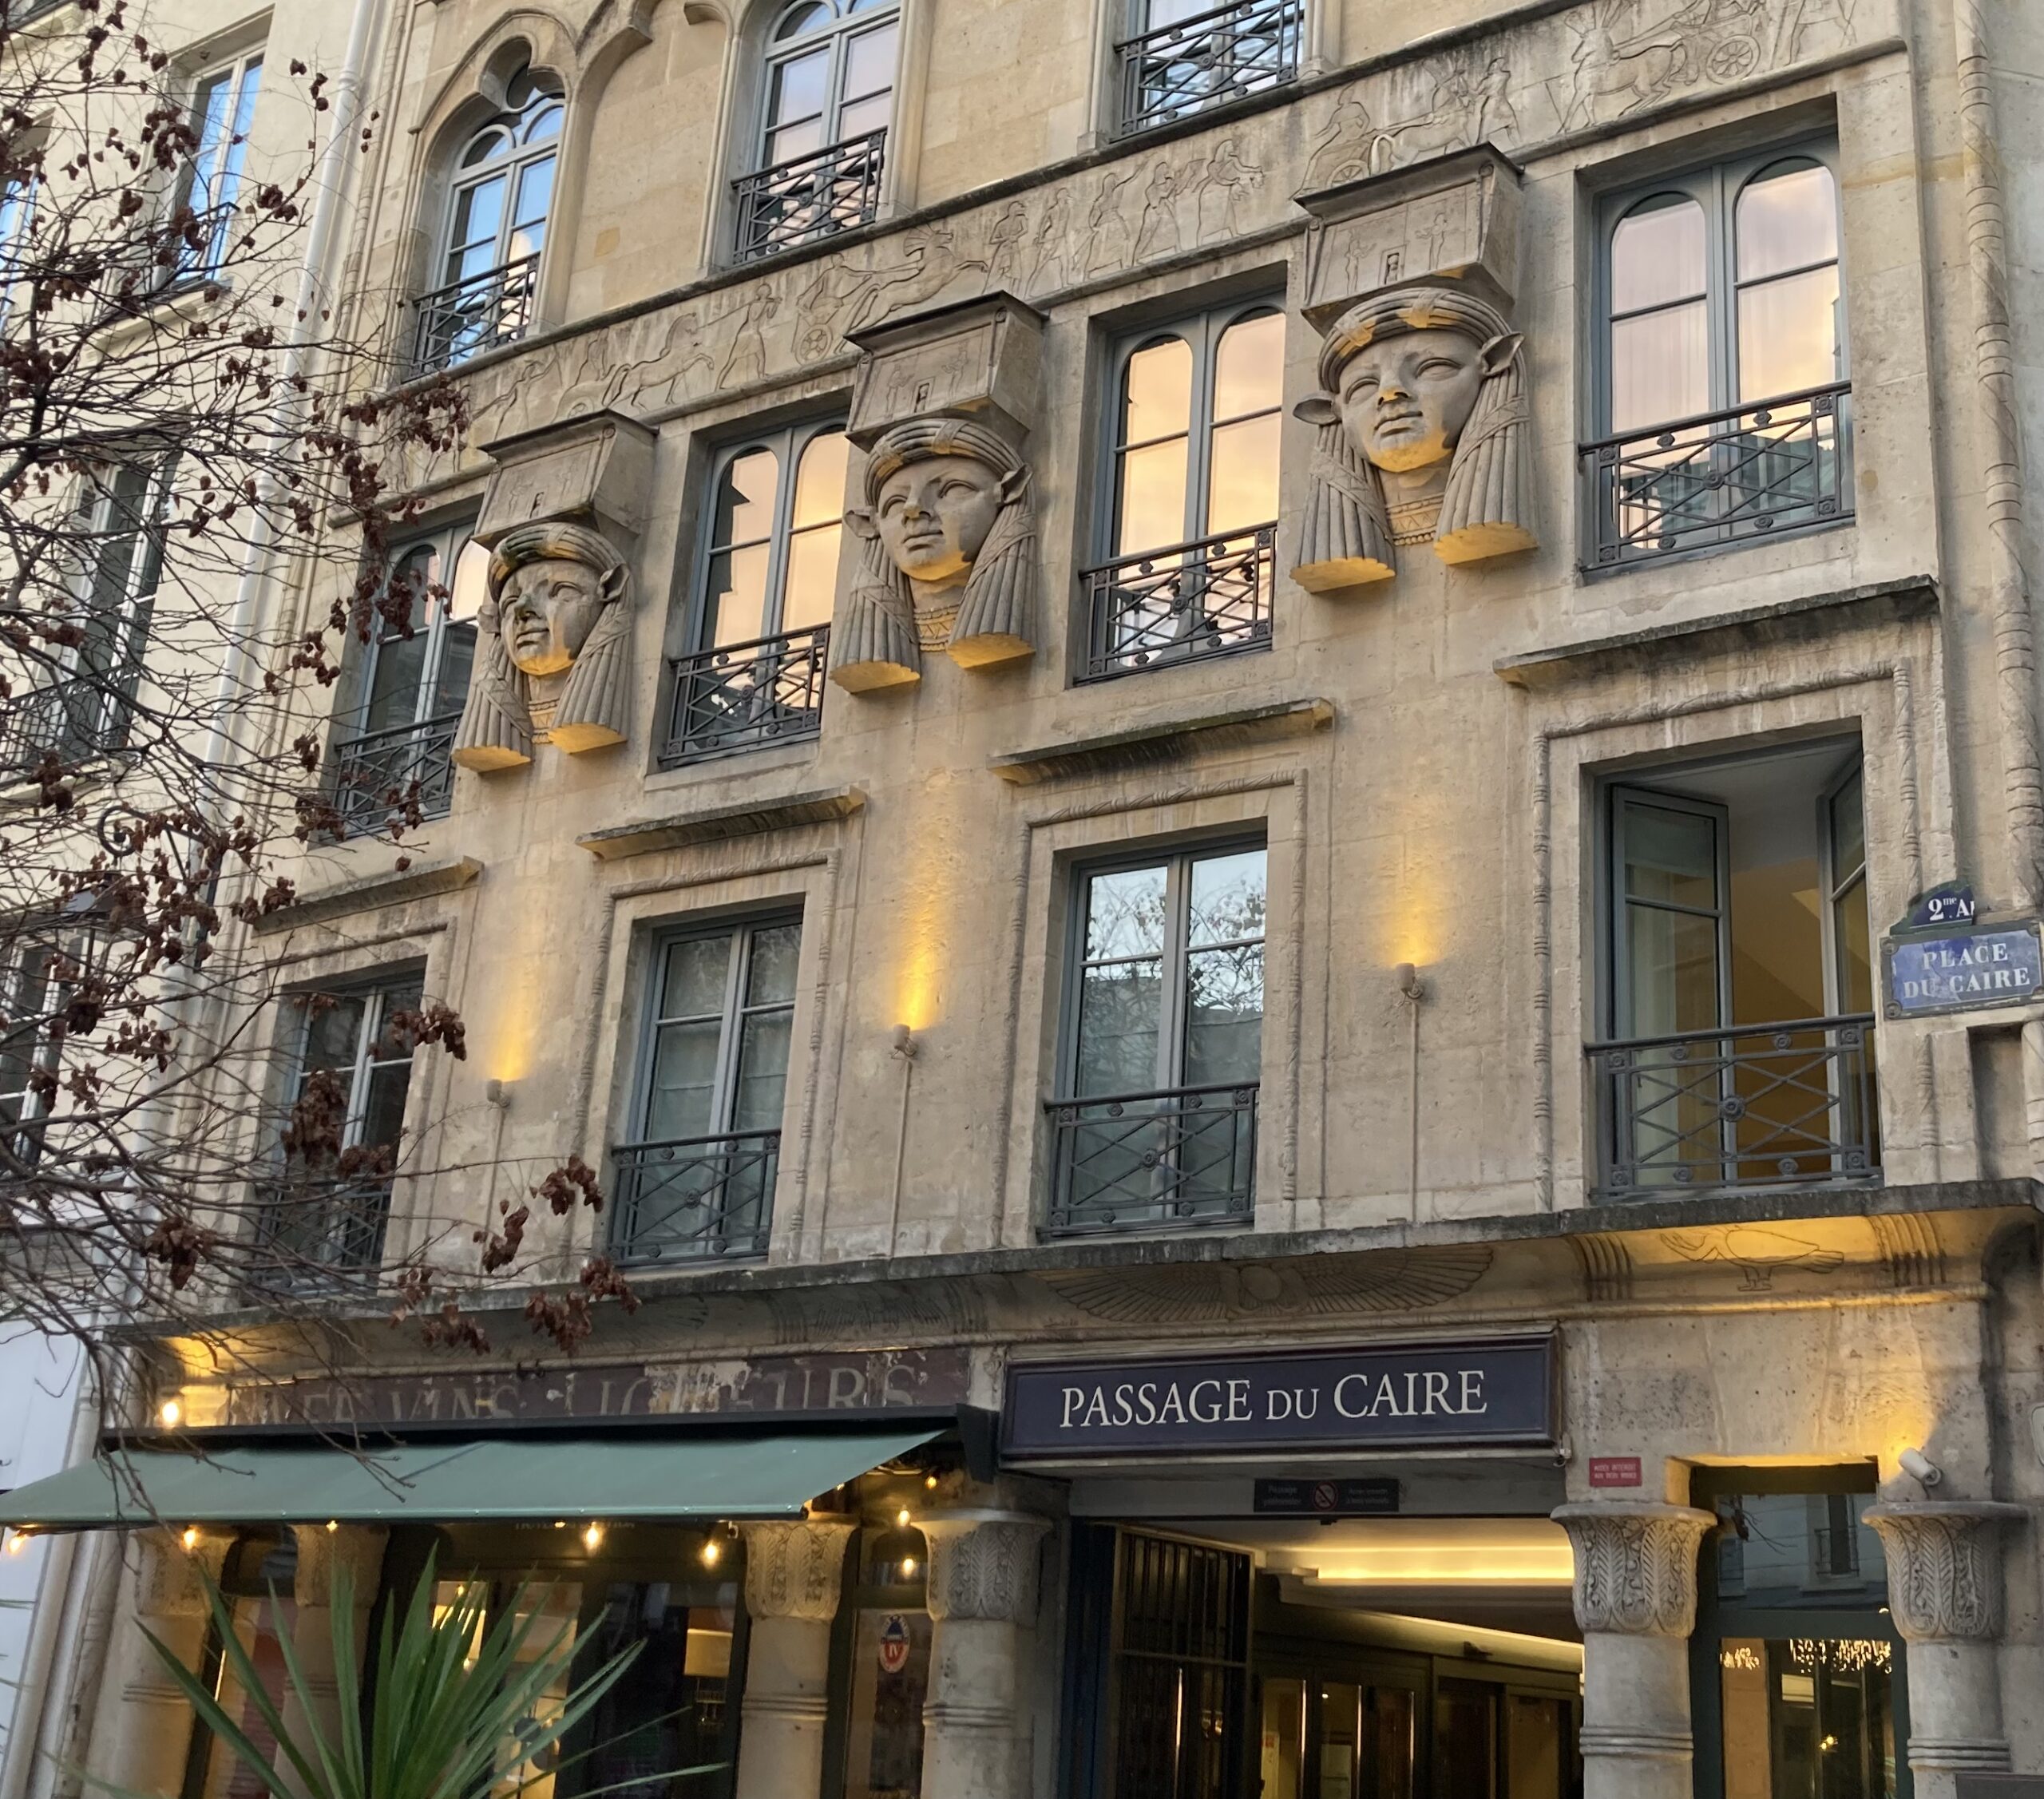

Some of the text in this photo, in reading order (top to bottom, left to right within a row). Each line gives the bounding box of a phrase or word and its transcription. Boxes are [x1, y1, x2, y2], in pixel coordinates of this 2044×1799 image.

[1923, 943, 2008, 970] PLACE
[1903, 967, 2030, 999] DU CAIRE
[1060, 1369, 1487, 1429] PASSAGE DU CAIRE
